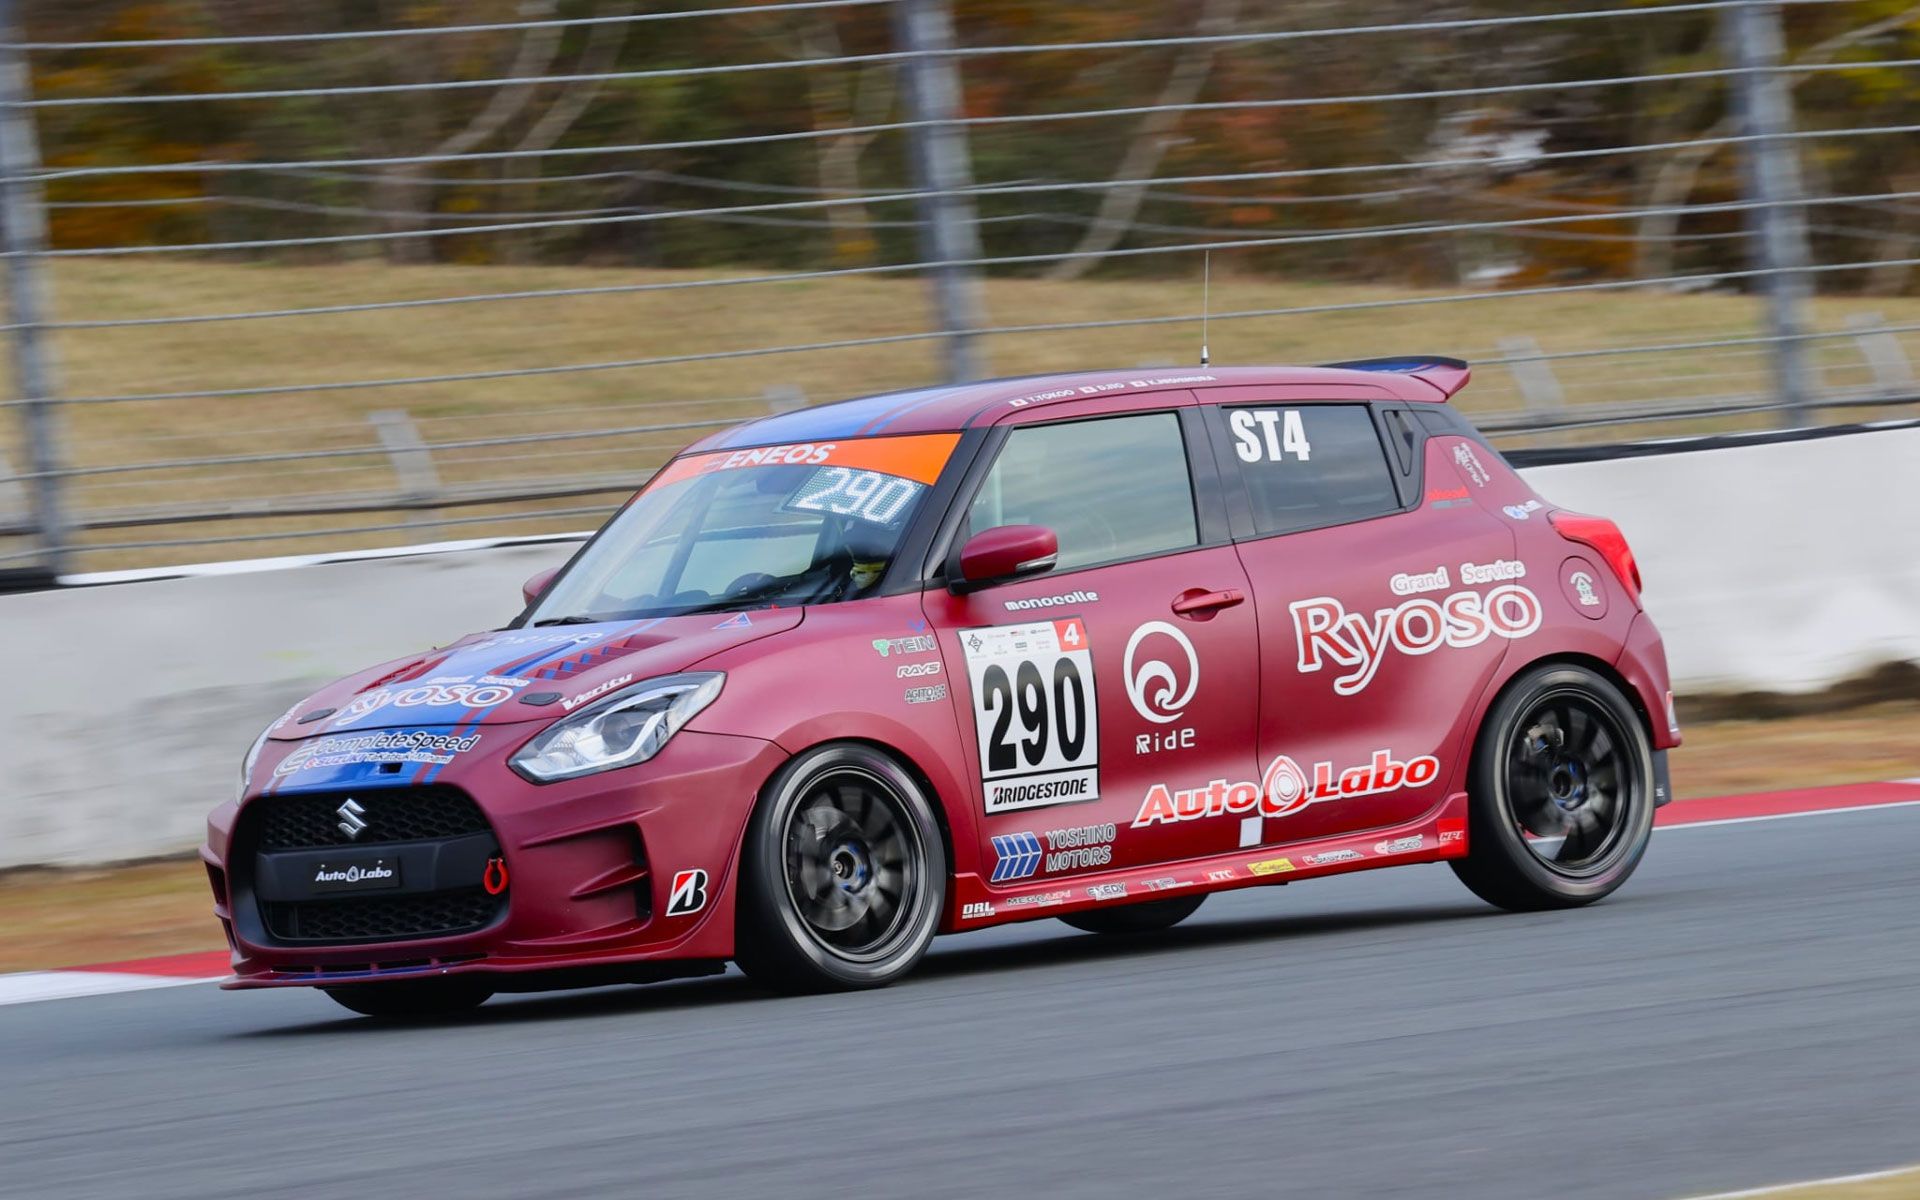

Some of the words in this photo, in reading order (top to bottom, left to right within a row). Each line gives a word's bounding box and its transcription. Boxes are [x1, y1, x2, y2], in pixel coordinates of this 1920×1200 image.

[1230, 410, 1311, 463] ST4
[720, 444, 837, 469] ENEOS
[794, 468, 916, 524] 290
[1390, 566, 1450, 595] Grand
[1460, 559, 1527, 584] Service
[1004, 590, 1099, 612] monocolle
[889, 634, 937, 654] TEIN
[1063, 623, 1080, 646] 4
[1289, 584, 1542, 697] Ryoso
[897, 662, 941, 678] RAYS
[983, 656, 1086, 772] 290
[1136, 728, 1196, 755] Ride
[993, 778, 1089, 805] BRIDGESTONE
[1130, 778, 1262, 829] Auto
[1313, 749, 1440, 802] Labo
[1045, 823, 1117, 850] YOSHINO
[1045, 845, 1112, 873] MOTORS
[315, 870, 346, 882] Auto
[359, 867, 393, 880] Labo
[1208, 870, 1234, 881] KTC
